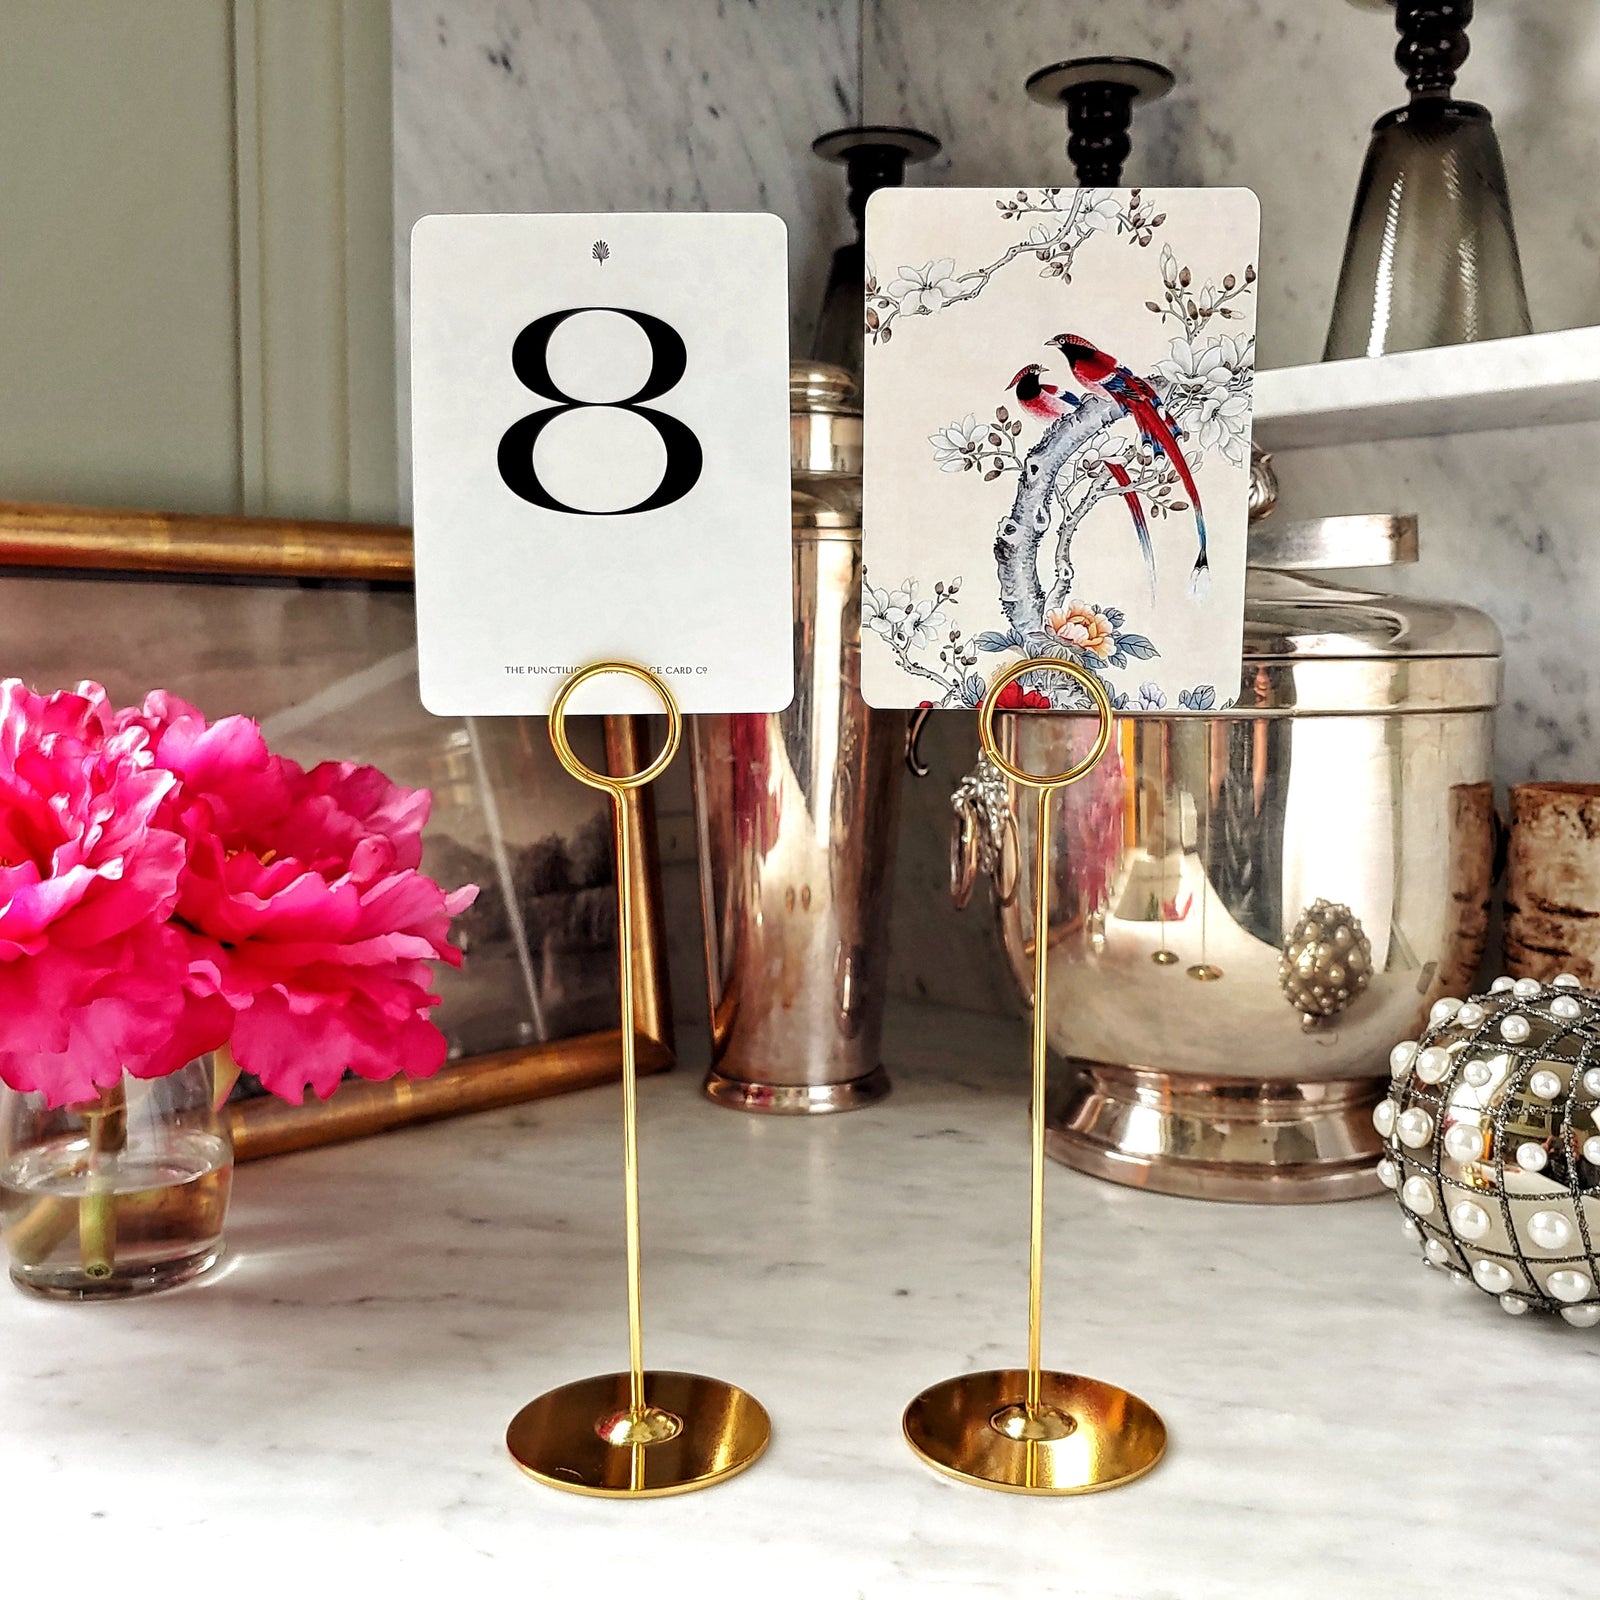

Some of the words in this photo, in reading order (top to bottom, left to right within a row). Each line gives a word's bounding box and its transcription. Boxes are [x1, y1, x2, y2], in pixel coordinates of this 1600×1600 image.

[497, 307, 703, 515] 8
[504, 666, 525, 674] THE
[527, 666, 582, 674] PUNCTILIO
[665, 666, 692, 674] CARD
